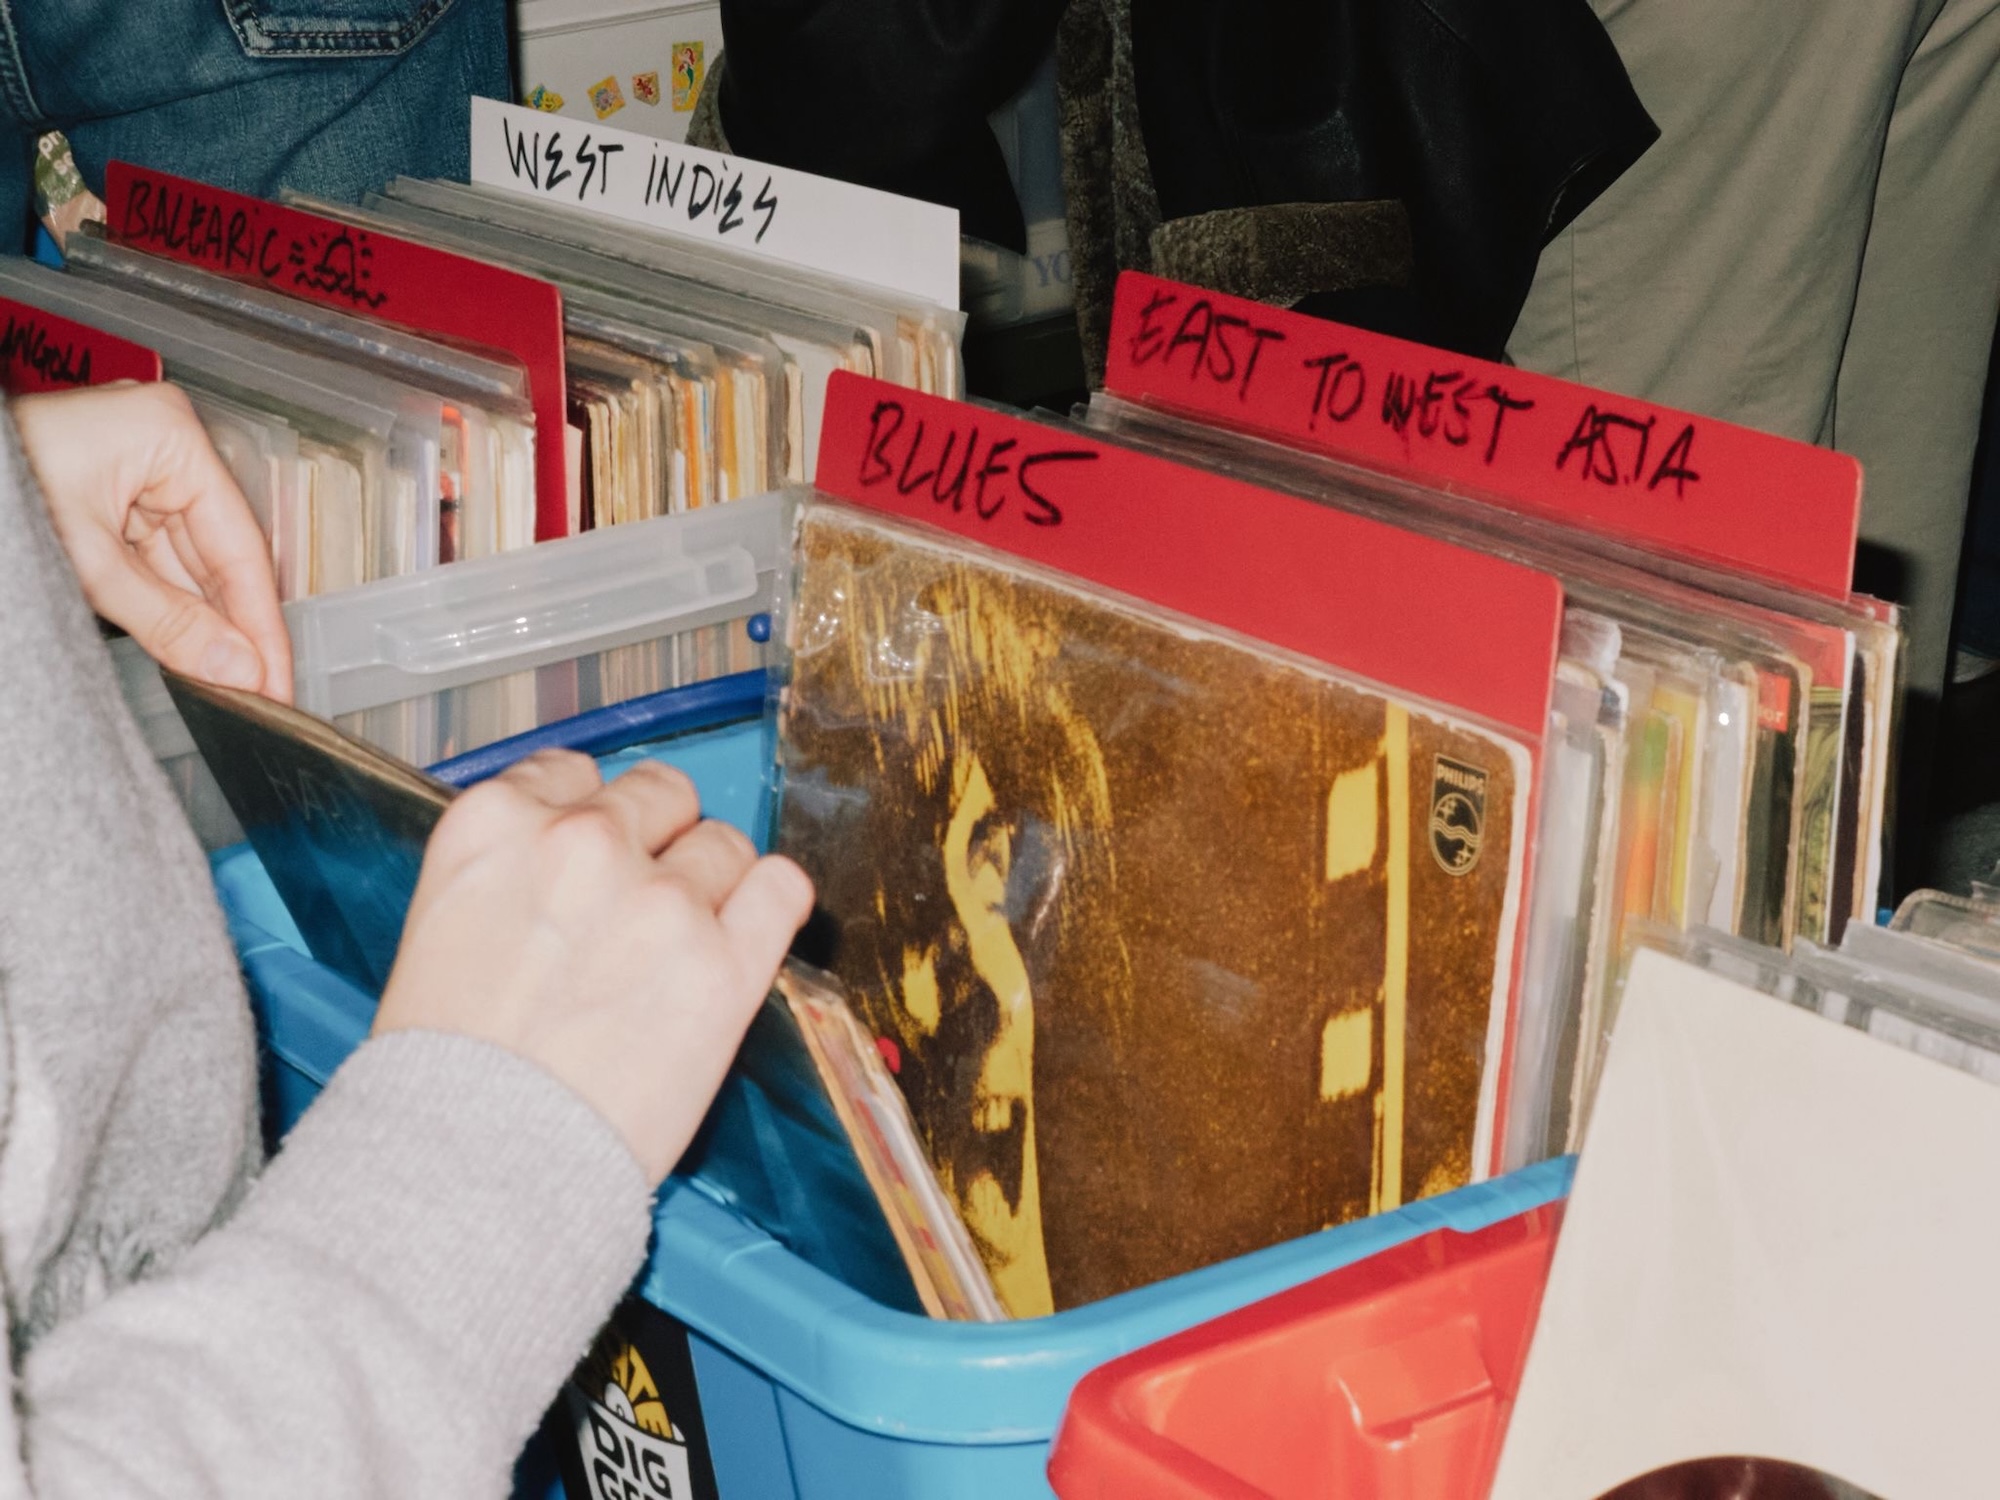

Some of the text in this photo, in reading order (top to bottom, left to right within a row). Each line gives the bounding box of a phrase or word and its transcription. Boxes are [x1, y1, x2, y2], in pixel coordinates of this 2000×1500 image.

[503, 117, 624, 200] WEST
[1129, 290, 1699, 499] EAST TO WEST ASIA
[859, 401, 1099, 526] BLUES
[587, 1404, 672, 1500] DIG
